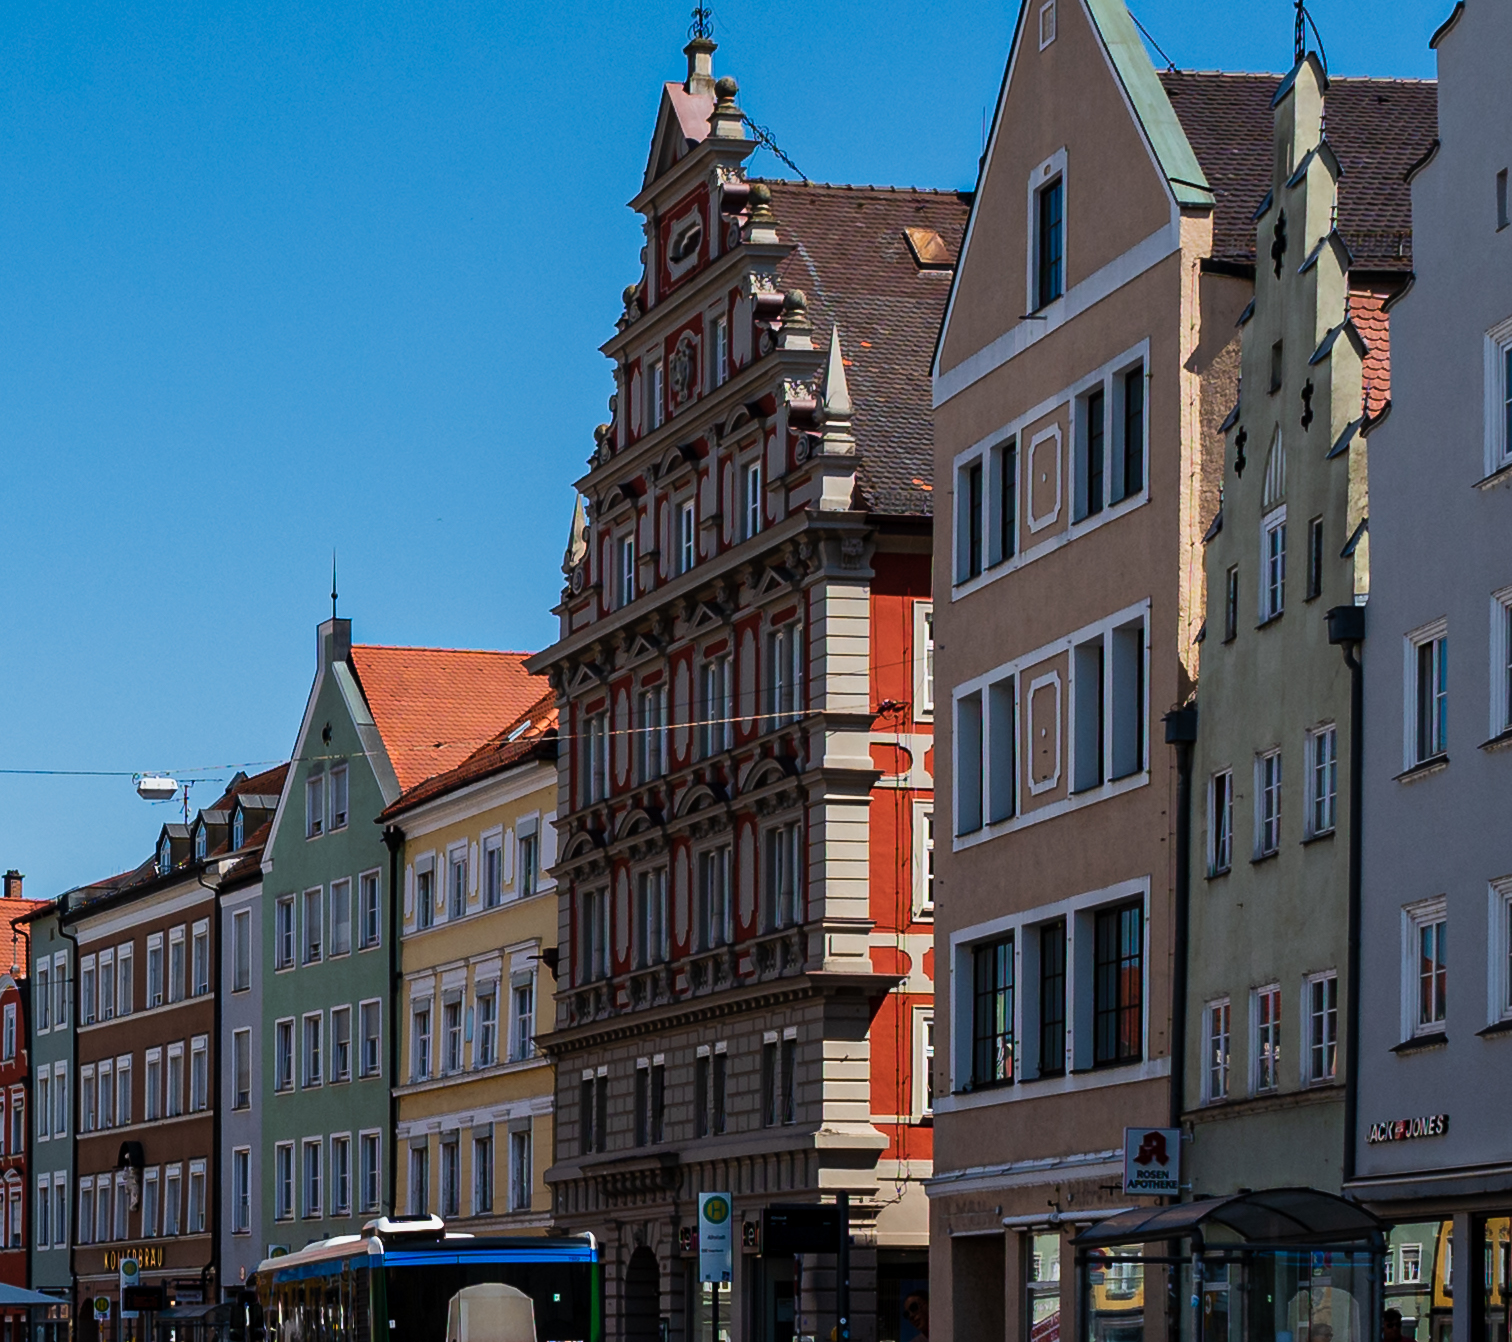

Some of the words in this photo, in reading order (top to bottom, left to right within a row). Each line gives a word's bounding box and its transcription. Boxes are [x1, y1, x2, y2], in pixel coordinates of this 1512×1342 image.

[1406, 1114, 1445, 1138] JONES
[1136, 1170, 1169, 1180] ROSEN
[1127, 1180, 1178, 1189] APOTHEKE
